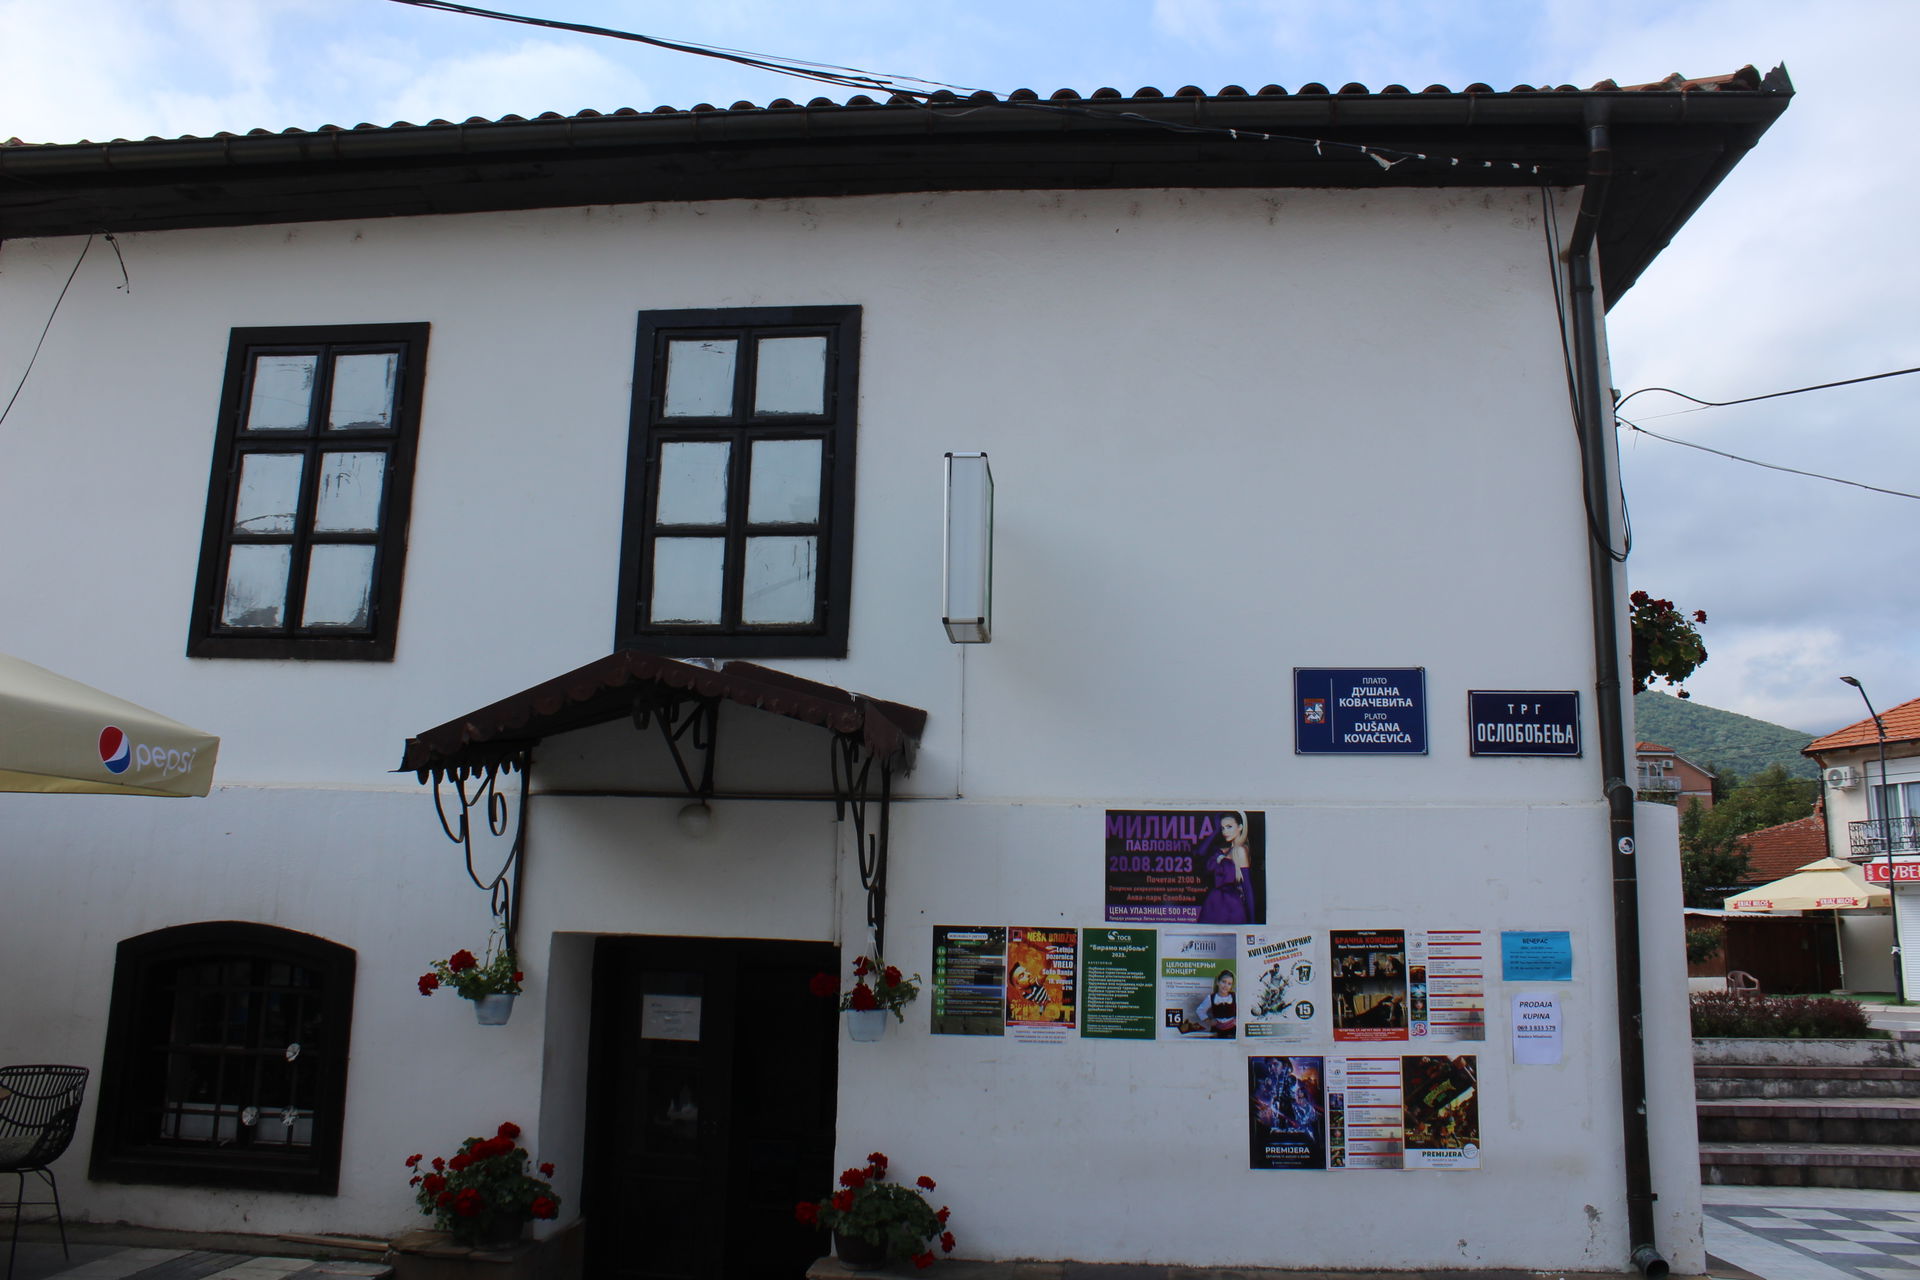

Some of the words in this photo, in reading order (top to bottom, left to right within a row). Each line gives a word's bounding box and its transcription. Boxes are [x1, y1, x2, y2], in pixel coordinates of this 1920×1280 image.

[1362, 677, 1387, 685] ПЛАТО
[1351, 686, 1400, 697] ДУШАНА
[1339, 697, 1413, 707] КОВАЧЕВИЋА
[1507, 703, 1542, 715] ТРГ
[1364, 712, 1387, 720] PLATO
[1355, 721, 1400, 732] DUŠANA
[1344, 731, 1412, 743] KOVAČEVIĆA
[1477, 722, 1574, 745] ОСЛОБОЂЕЊА
[136, 743, 197, 776] pepsi
[1107, 815, 1214, 845] МИЛИЦА
[1126, 839, 1191, 852] ПАВЛОВИЋ
[1109, 856, 1193, 873] 20.08.2023
[1879, 865, 1920, 879] CYBE
[1109, 906, 1128, 915] ЦЕНА
[1129, 907, 1167, 917] УЛАЗНИЦЕ
[1182, 908, 1197, 916] РСД
[1286, 935, 1313, 948] ТУРНИР
[1166, 961, 1216, 969] ЦЕЛОВЕЧЕРЊИ
[1298, 1004, 1311, 1015] 15
[1168, 1014, 1181, 1023] 16
[1265, 1146, 1310, 1154] PREMIJERA
